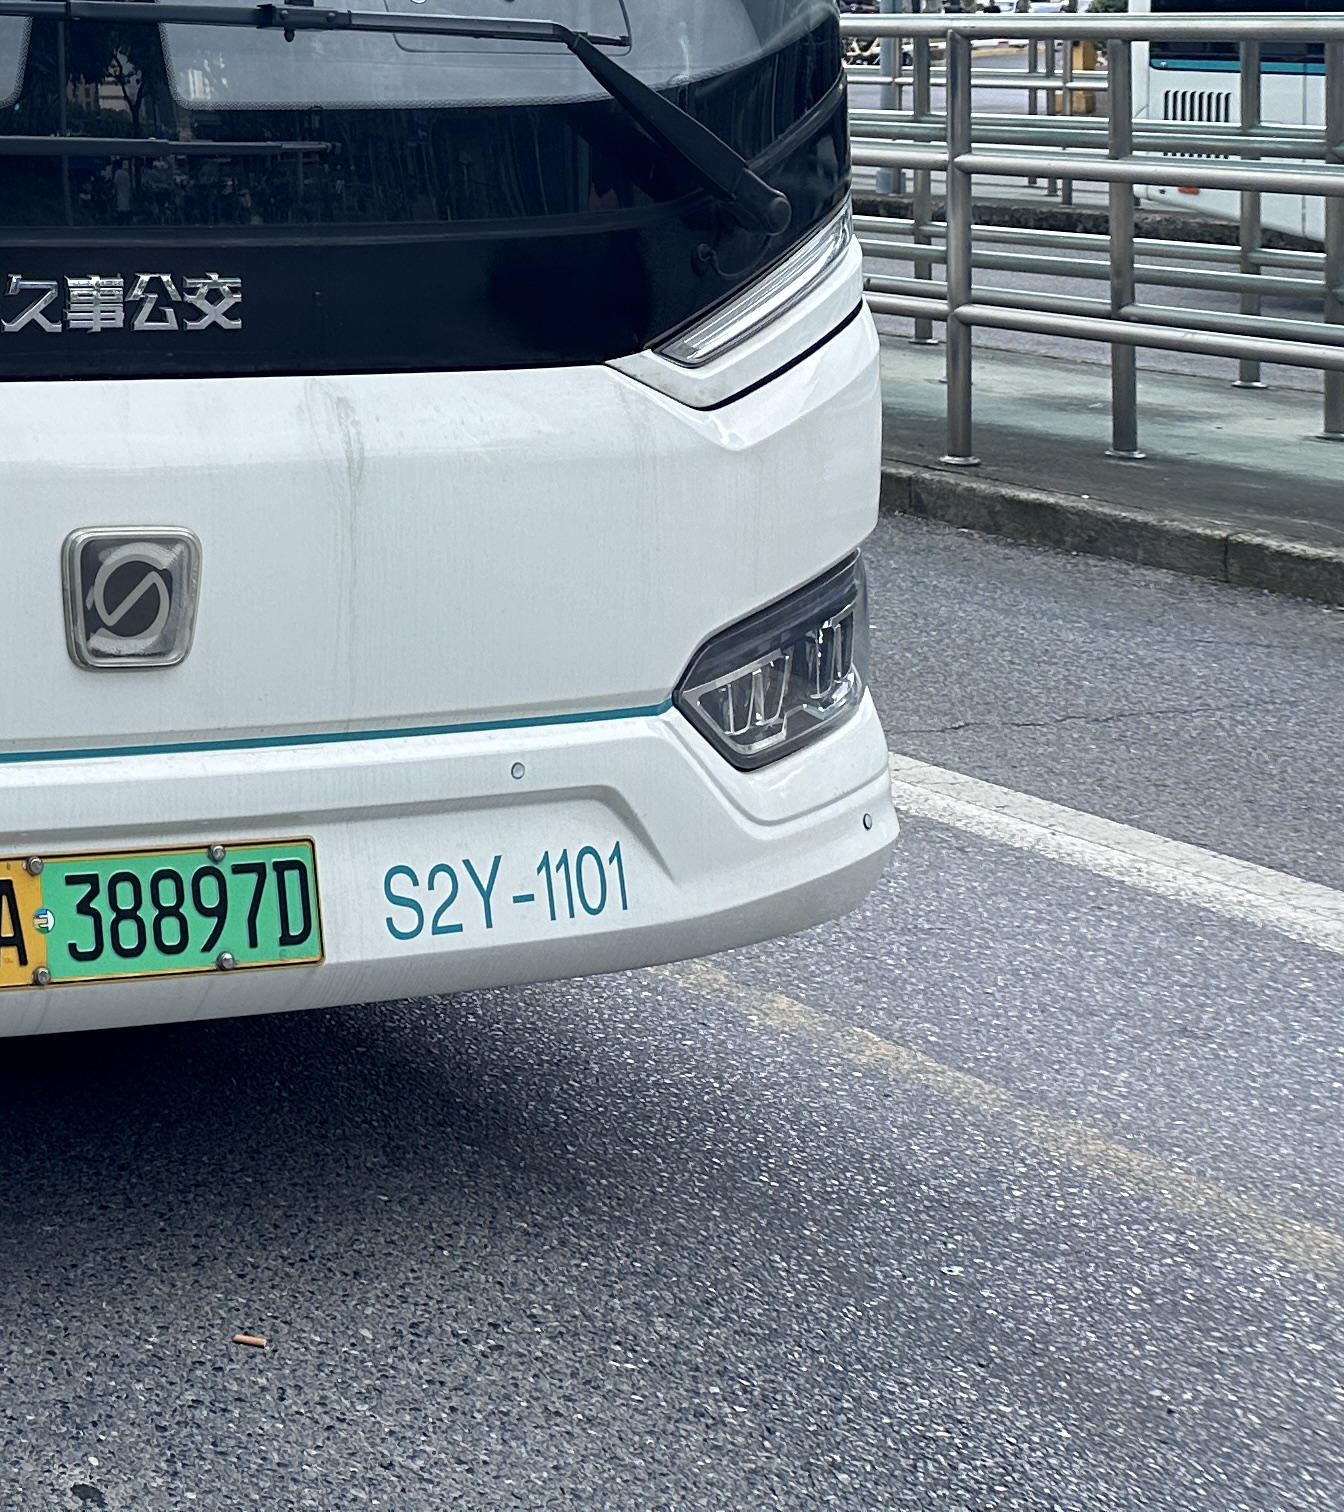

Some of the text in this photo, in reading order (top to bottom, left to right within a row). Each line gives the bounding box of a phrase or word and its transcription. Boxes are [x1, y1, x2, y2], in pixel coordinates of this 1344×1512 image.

[0, 272, 243, 334] 久事公交
[384, 841, 629, 941] S2Y-1101
